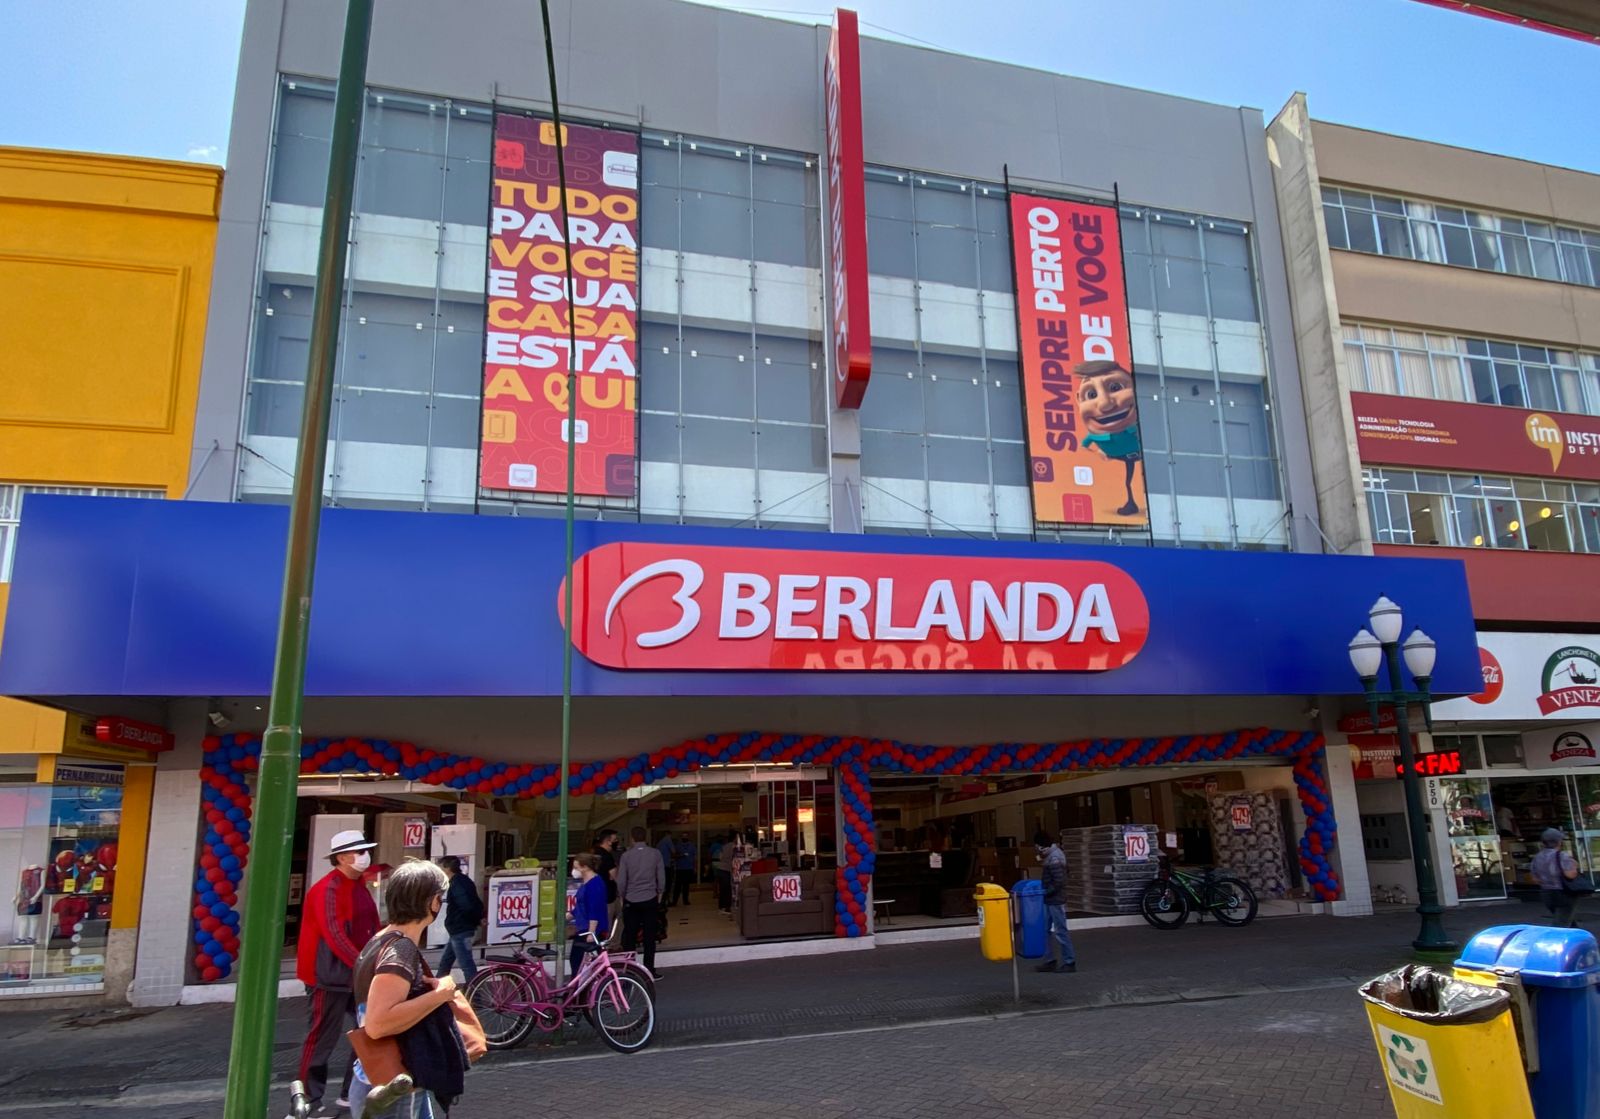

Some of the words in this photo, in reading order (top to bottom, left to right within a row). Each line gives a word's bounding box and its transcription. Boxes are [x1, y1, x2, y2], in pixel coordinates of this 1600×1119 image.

[495, 179, 637, 221] TUDO
[492, 207, 637, 250] PARA
[491, 239, 636, 281] VOCÊ
[1028, 206, 1066, 312] PERTO
[1069, 212, 1109, 307] VOCÊ
[490, 269, 518, 298] E
[530, 274, 636, 311] SUA
[488, 300, 635, 341] CASA
[1080, 314, 1114, 362] DE
[486, 331, 635, 376] ESTÁ
[1037, 318, 1078, 452] SEMPRE
[1399, 419, 1435, 428] TECNOLOGIA
[1569, 446, 1585, 454] DE
[718, 572, 1121, 643] BERLANDA
[124, 727, 163, 745] BERLANDA
[1556, 748, 1589, 758] VENEZA
[57, 768, 124, 785] PERNAMBUCANAS
[1429, 779, 1438, 806] 550
[1127, 836, 1145, 856] 179
[775, 879, 798, 899] 849
